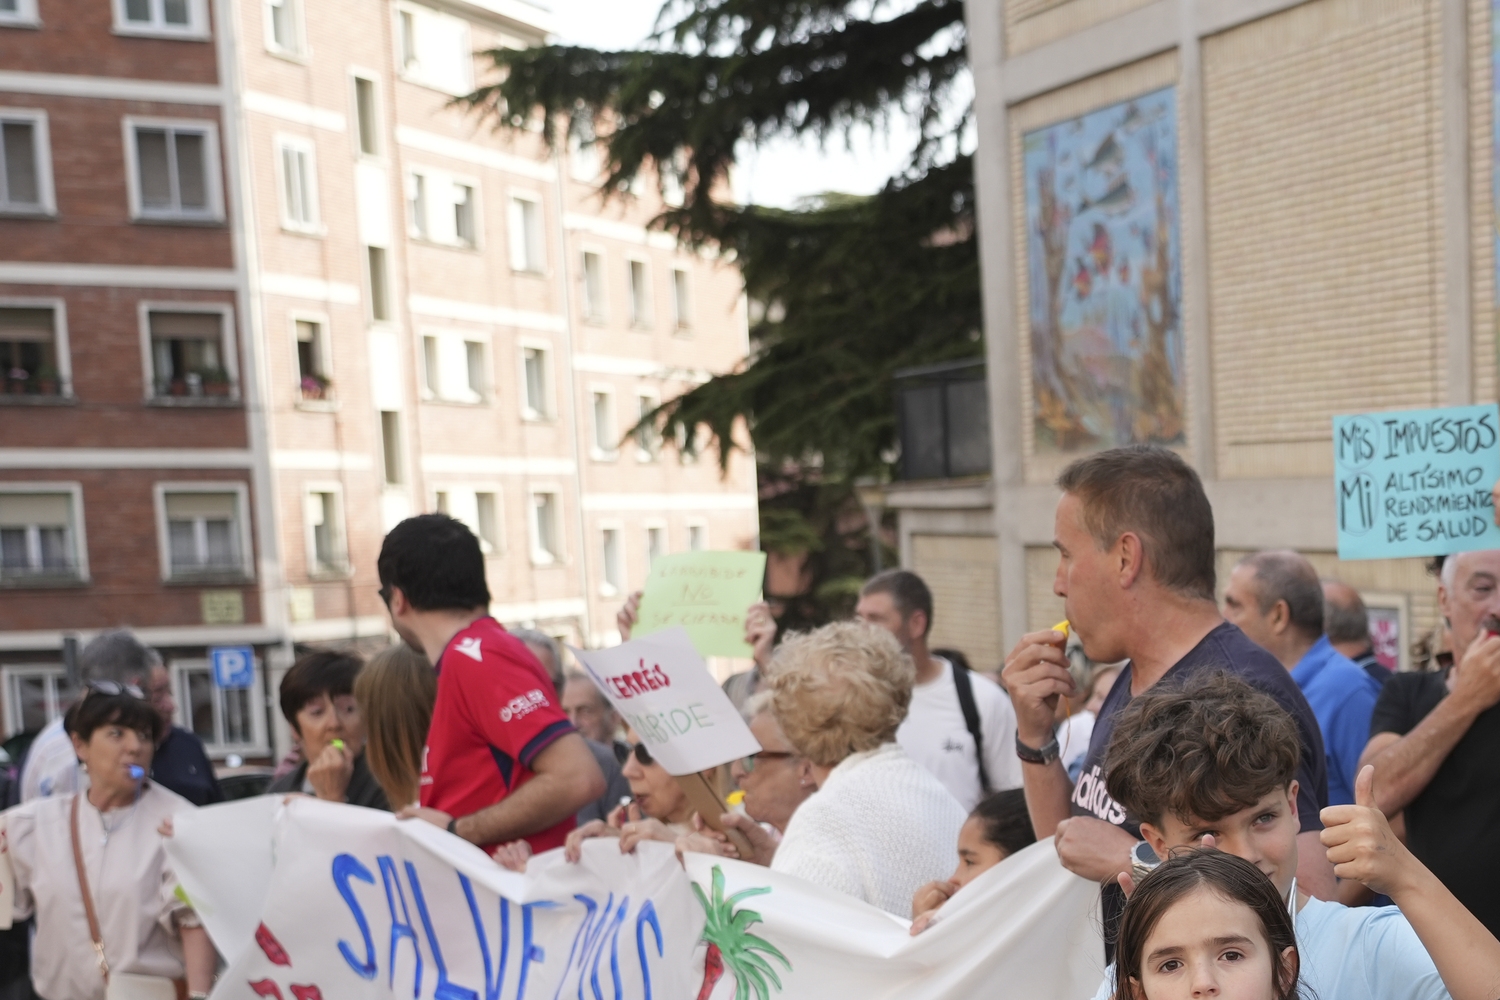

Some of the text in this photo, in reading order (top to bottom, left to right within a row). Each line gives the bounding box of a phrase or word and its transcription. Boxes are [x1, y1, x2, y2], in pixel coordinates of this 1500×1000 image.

[1383, 413, 1497, 460] IMPUESTOS
[1386, 515, 1488, 544] DE SALUD
[681, 583, 715, 601] NO
[221, 651, 246, 685] P
